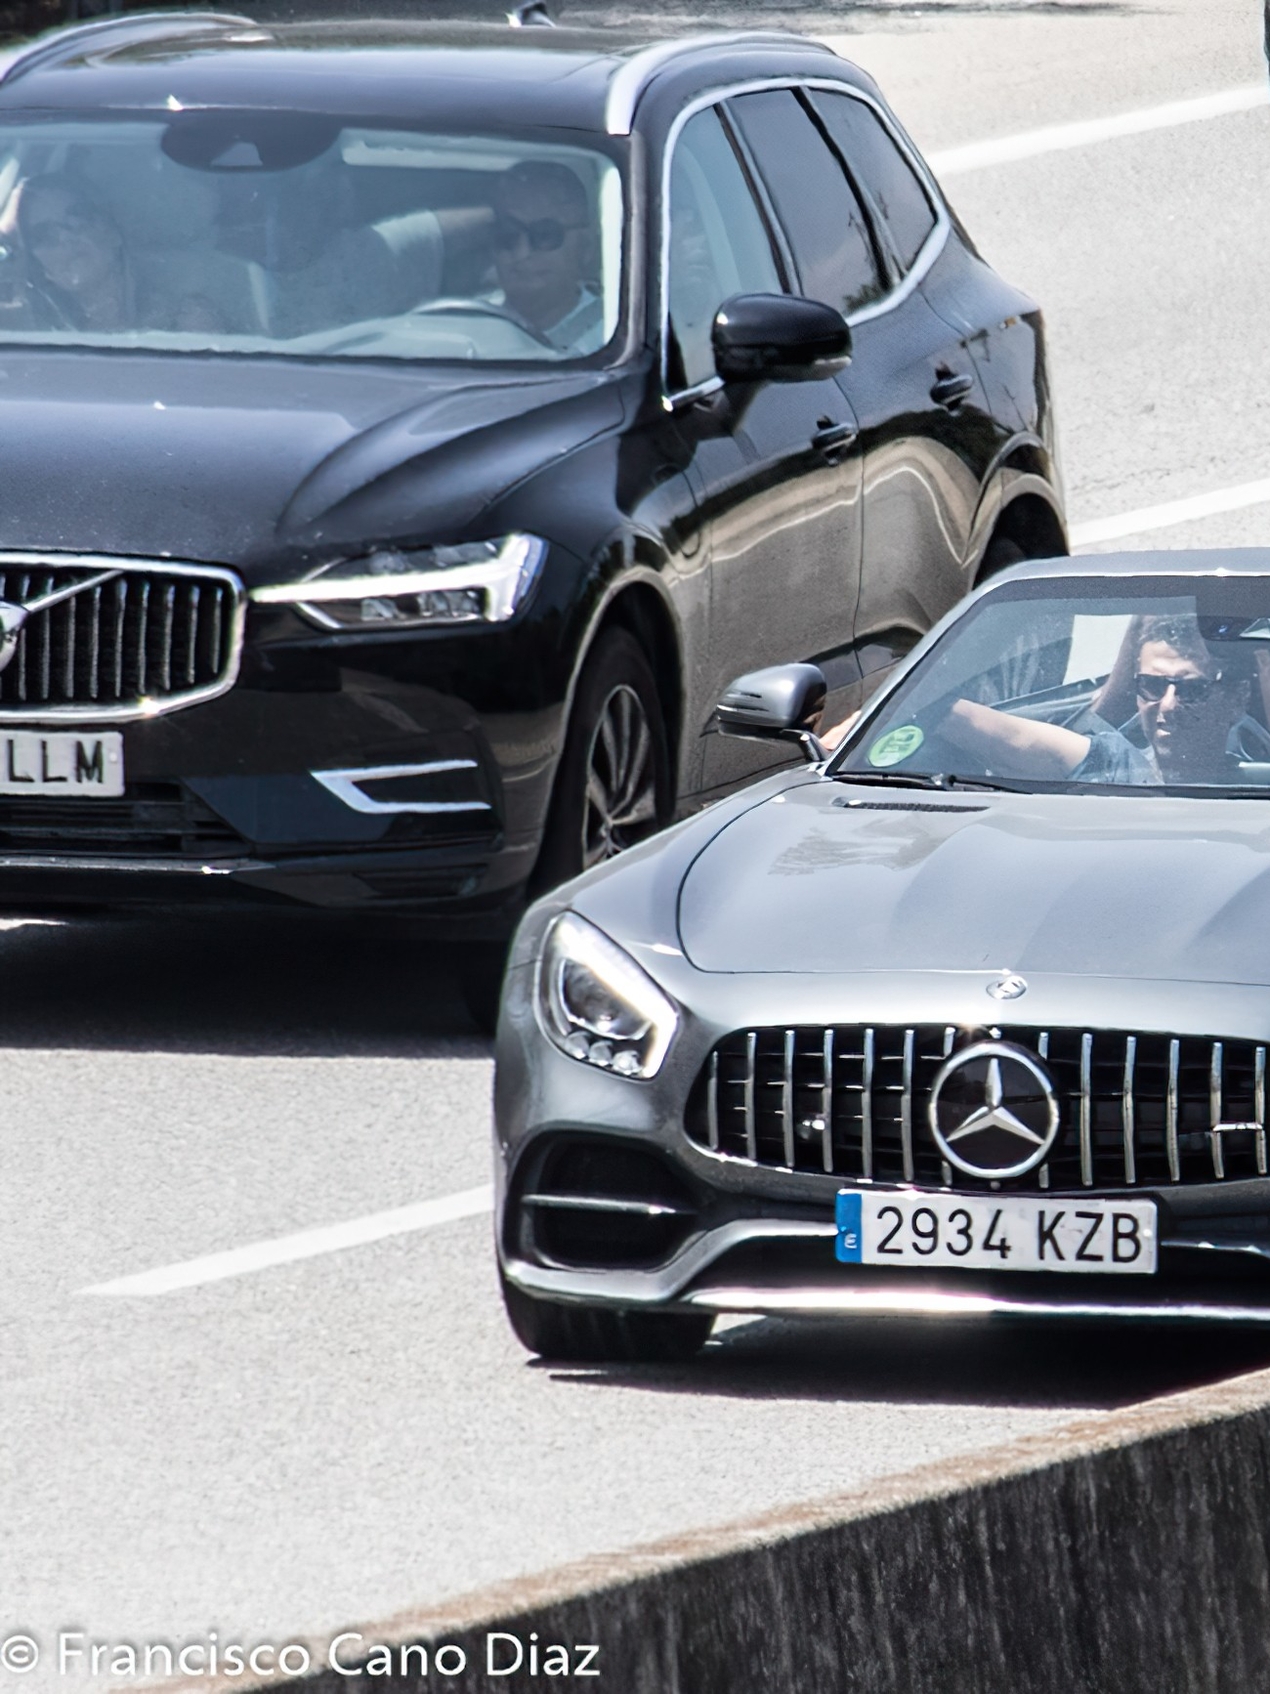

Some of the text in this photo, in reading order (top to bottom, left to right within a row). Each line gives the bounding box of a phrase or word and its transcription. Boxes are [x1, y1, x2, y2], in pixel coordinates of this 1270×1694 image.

[7, 739, 104, 784] LLM
[876, 1206, 1012, 1259] 2934
[1037, 1210, 1142, 1263] KZB
